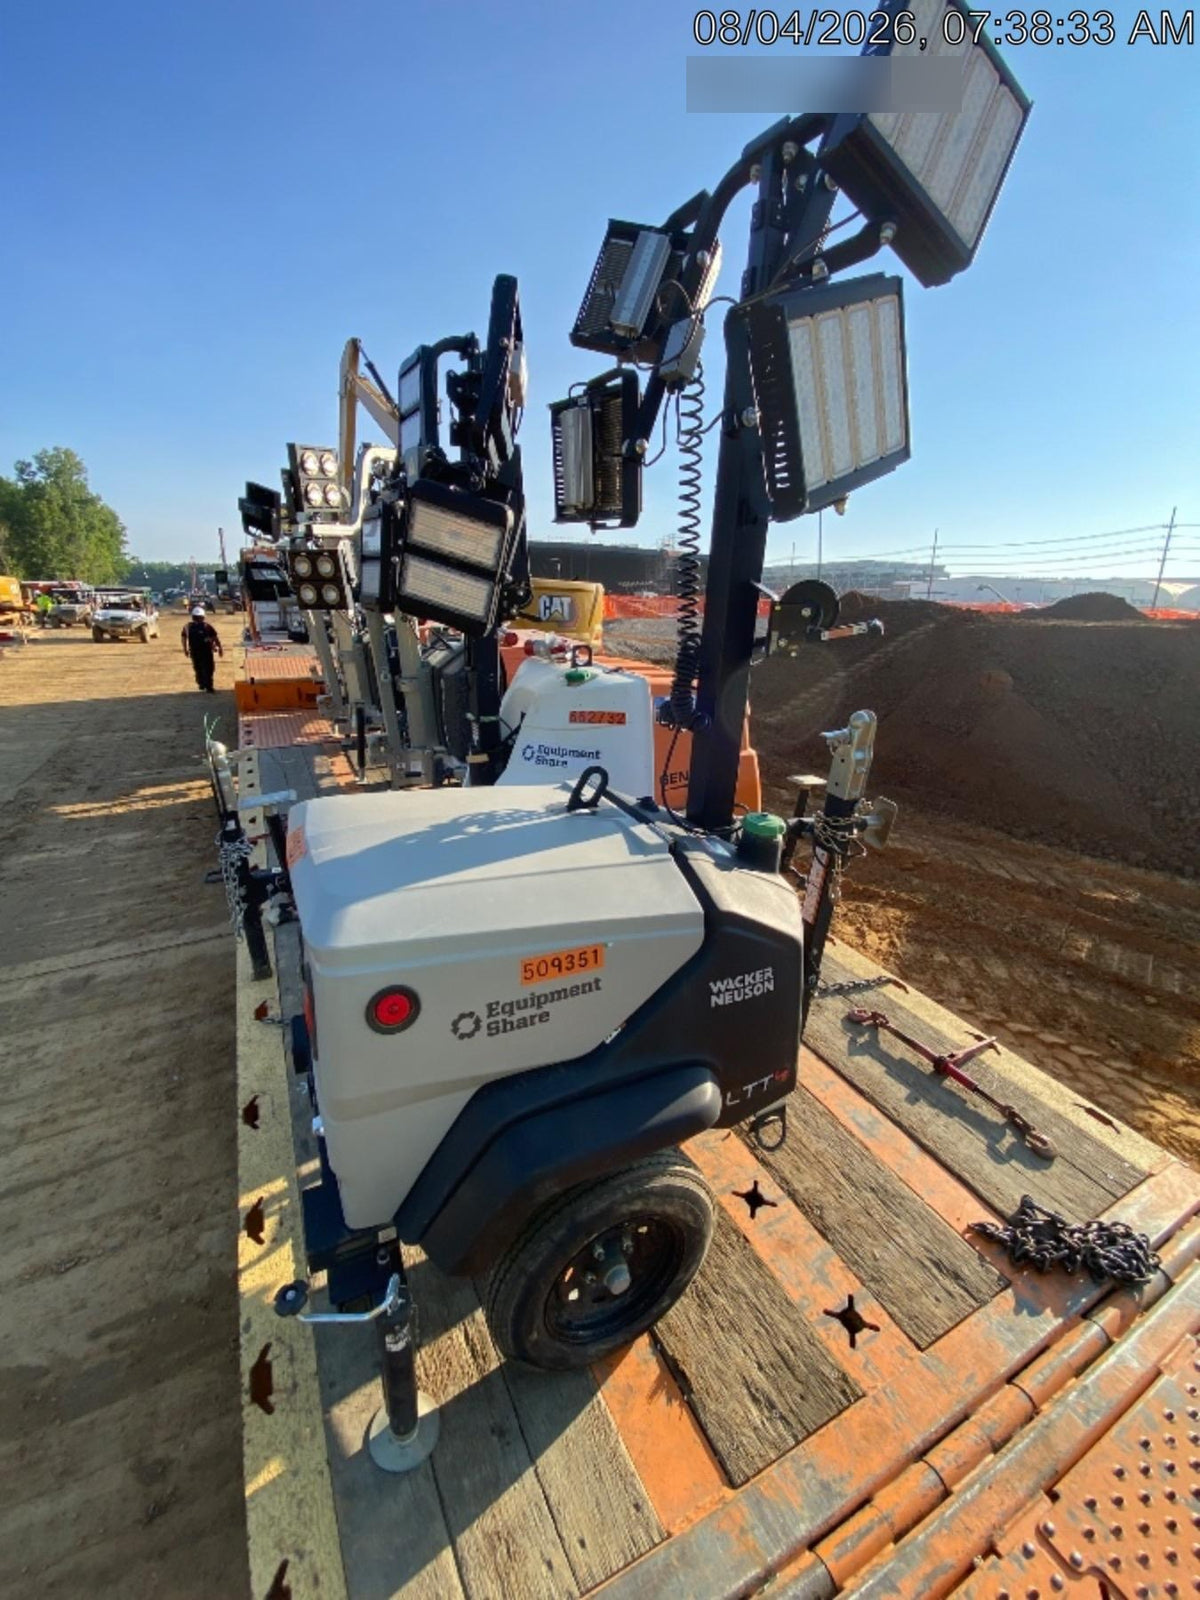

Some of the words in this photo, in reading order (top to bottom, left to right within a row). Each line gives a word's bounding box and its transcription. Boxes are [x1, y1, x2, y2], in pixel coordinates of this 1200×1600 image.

[539, 594, 572, 621] CAT
[534, 754, 568, 768] Share
[537, 744, 602, 760] Equipment
[523, 949, 600, 981] 509351
[709, 967, 774, 994] WACKER
[710, 979, 775, 1008] NEUSON
[486, 977, 602, 1019] Equipment
[486, 1011, 551, 1038] Share
